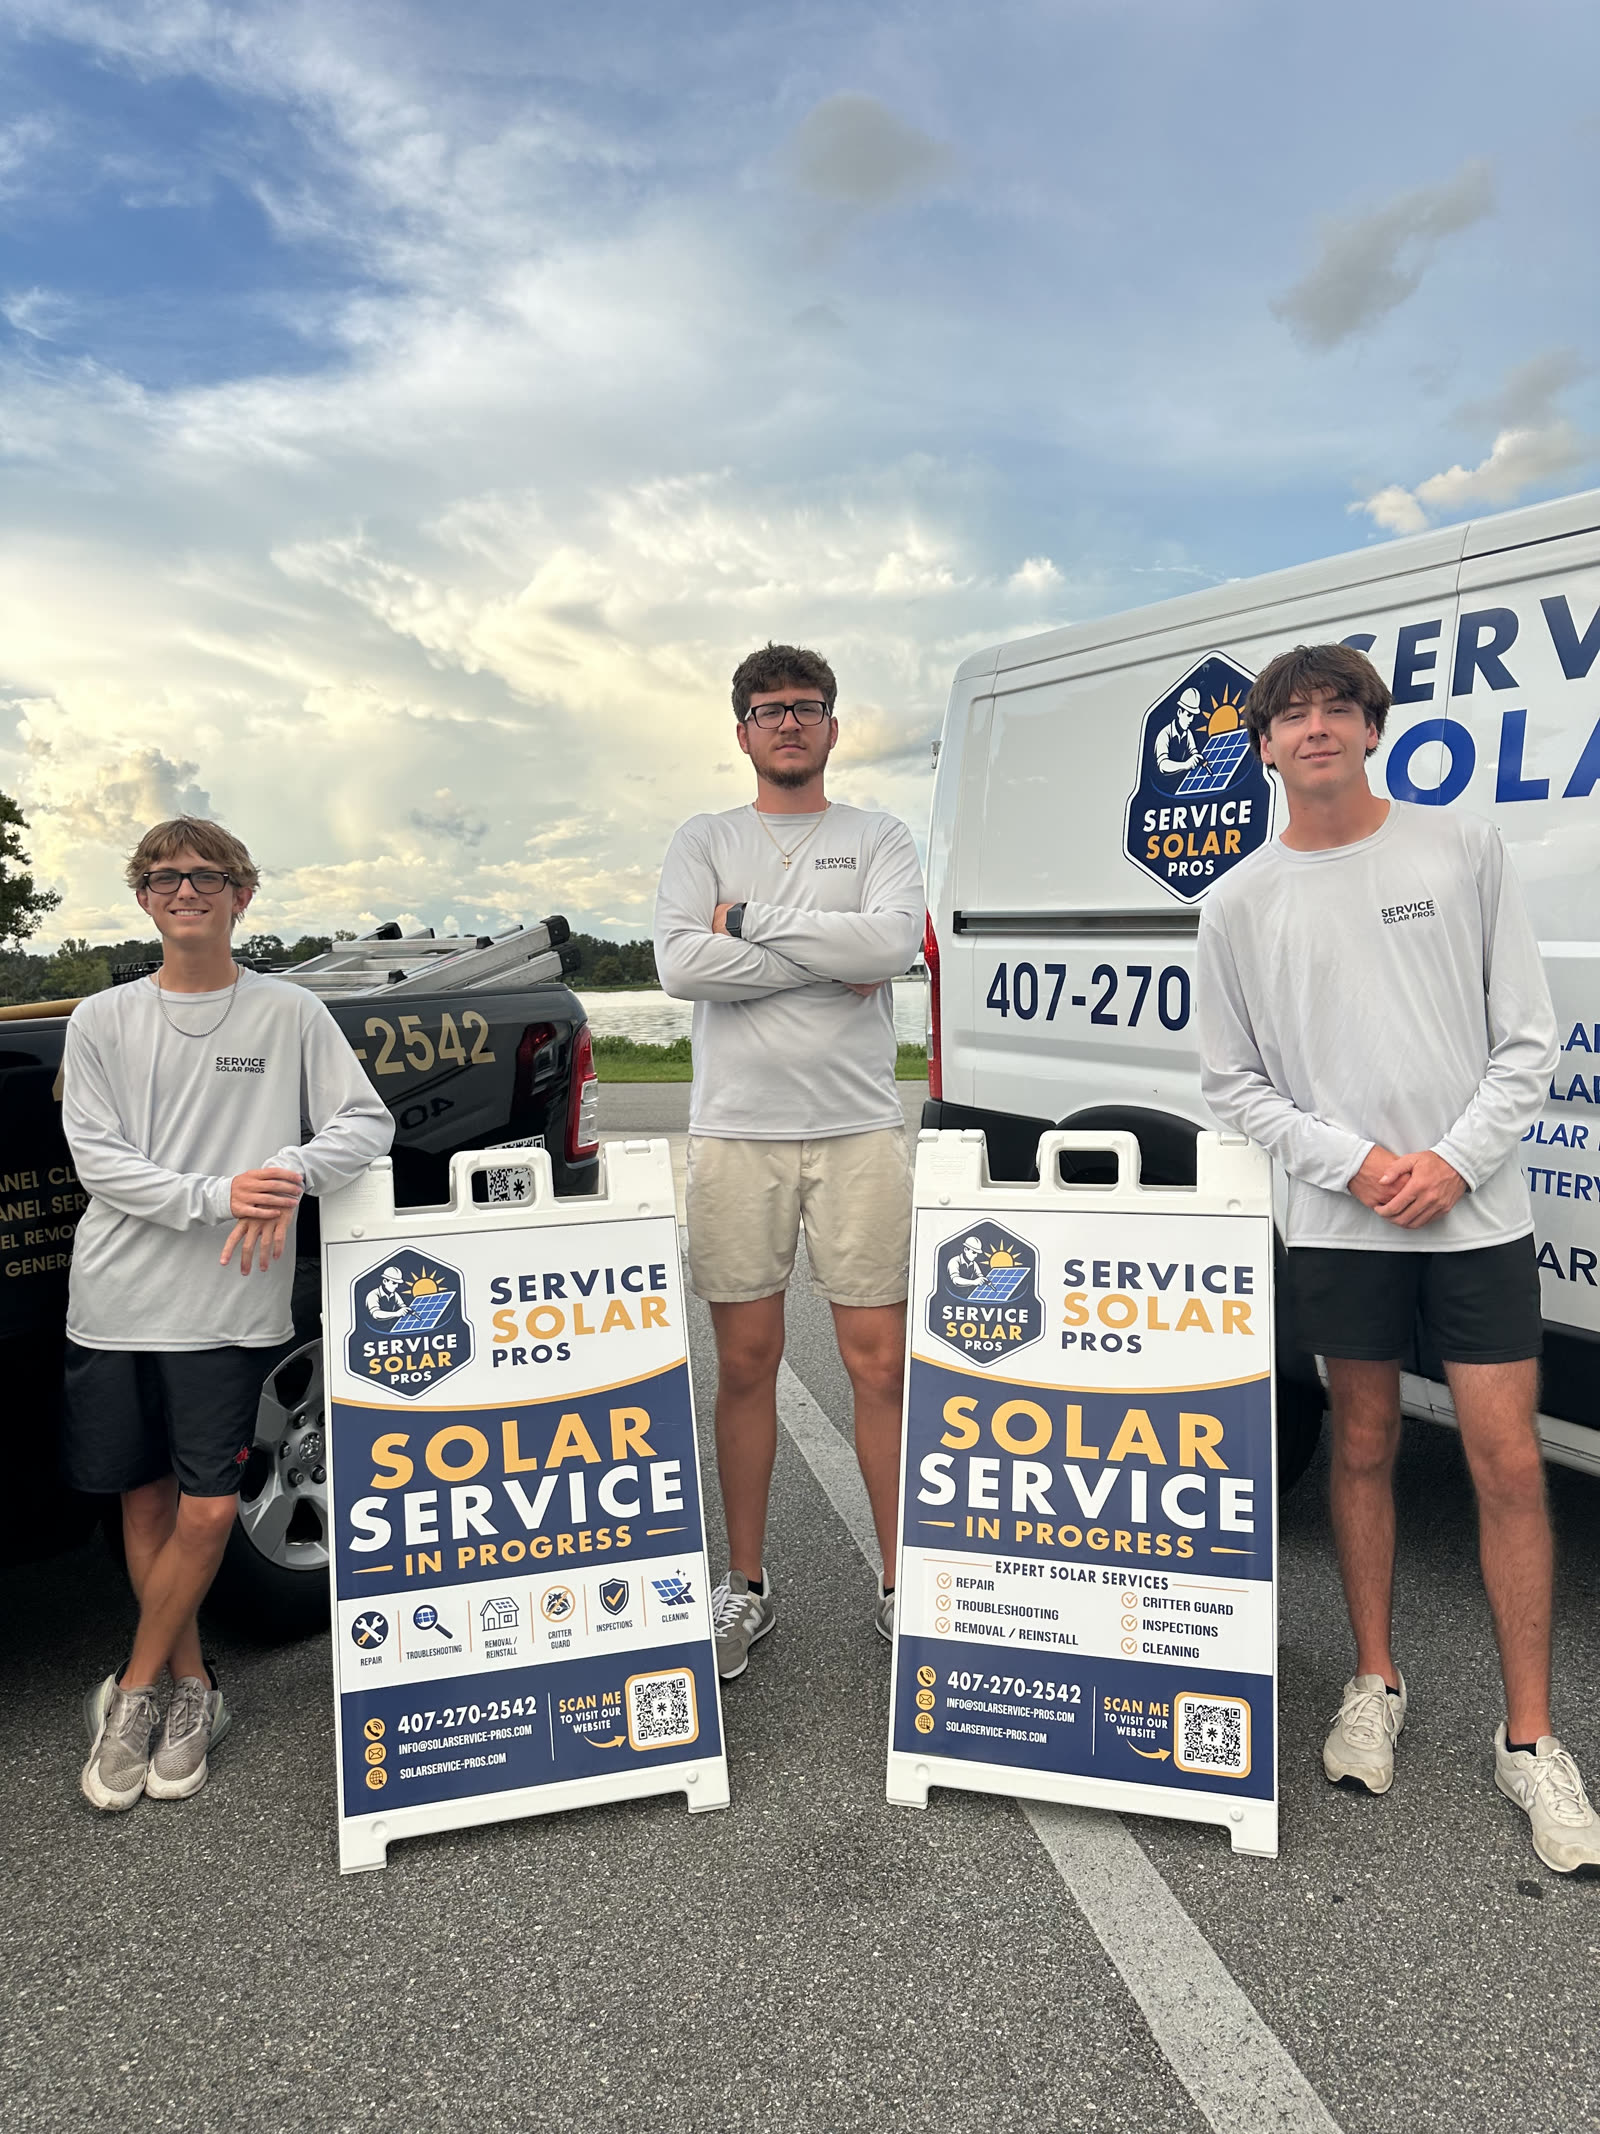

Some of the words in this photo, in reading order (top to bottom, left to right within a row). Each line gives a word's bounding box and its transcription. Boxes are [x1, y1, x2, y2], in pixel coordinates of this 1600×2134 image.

[1143, 800, 1252, 832] SERVICE
[1146, 829, 1242, 859] SOLAR
[815, 857, 857, 866] SERVICE
[1167, 859, 1215, 877] PROS
[1381, 899, 1435, 918] SERVICE
[1383, 913, 1410, 925] SOLAR
[1412, 909, 1436, 919] PROS
[986, 961, 1197, 1031] 407-270
[215, 1065, 243, 1073] SOLAR
[244, 1066, 265, 1074] PROS
[216, 1056, 267, 1067] SERVICE
[48, 1165, 80, 1185] CL
[1520, 1165, 1600, 1203] TTER
[24, 1223, 78, 1246] REMO
[490, 1263, 667, 1305] SERVICE
[1062, 1259, 1255, 1295] SERVICE
[492, 1296, 671, 1344] SOLAR
[942, 1305, 1028, 1324] SERVICE
[1062, 1291, 1255, 1335] SOLAR
[946, 1321, 1022, 1341] SOLAR
[363, 1333, 457, 1357] SERVICE
[964, 1339, 1003, 1352] PROS
[1061, 1331, 1142, 1354] PROS
[369, 1351, 452, 1375] SOLAR
[492, 1342, 571, 1368] PROS
[391, 1370, 432, 1385] PROS
[940, 1395, 1229, 1470] SOLAR
[370, 1406, 658, 1489] SOLAR
[917, 1452, 1255, 1533] SERVICE
[348, 1459, 684, 1552] SERVICE
[966, 1516, 999, 1541] IN
[1015, 1521, 1194, 1558] PROGRESS
[405, 1550, 442, 1576] IN
[457, 1525, 632, 1569] PROGRESS
[956, 1577, 995, 1591] REPAIR
[995, 1560, 1045, 1578] EXPERT
[1050, 1566, 1097, 1584] SOLAR
[1102, 1571, 1169, 1591] SERVICES
[956, 1599, 1059, 1621] TROUBLESHOOTING
[1142, 1596, 1191, 1612] CRITTER
[1194, 1601, 1234, 1616] GUARD
[596, 1620, 633, 1633] INSPECTIONS
[661, 1612, 689, 1623] CLEANING
[548, 1628, 572, 1640] CRITTER
[954, 1621, 1006, 1639] REMOVAL
[1008, 1628, 1016, 1639] /
[1019, 1629, 1079, 1646] REINSTALL
[1142, 1619, 1219, 1638] INSPECTIONS
[406, 1644, 463, 1660] TROUBLESHOOTING
[484, 1638, 513, 1649] REMOVAL
[486, 1648, 518, 1660] REINSTALL
[550, 1639, 571, 1650] GUARD
[1142, 1642, 1200, 1659] CLEANING
[360, 1656, 383, 1667] REPAIR
[947, 1671, 1081, 1704] 407-270-2542
[559, 1694, 597, 1712] SCAN
[602, 1691, 621, 1706] ME
[946, 1697, 1075, 1723] INFO@SOLARSERVICE-PROS.COM
[1103, 1696, 1143, 1714] SCAN
[1148, 1701, 1170, 1717] ME
[397, 1696, 537, 1734] 407-270-2542
[560, 1714, 573, 1724] TO
[575, 1710, 599, 1722] VISIT
[601, 1706, 621, 1718] OUR
[1104, 1713, 1117, 1723] TO
[1120, 1714, 1145, 1727] VISIT
[1147, 1717, 1168, 1730] OUR
[573, 1719, 611, 1734] WEBSITE
[945, 1720, 1048, 1744] SOLARSERVICE-PROS.COM
[1116, 1725, 1156, 1740] WEBSITE
[398, 1724, 532, 1756] INFO@SOLARSERVICE-PROS.COM
[400, 1752, 507, 1780] SOLARSERVICE-PROS.COM
